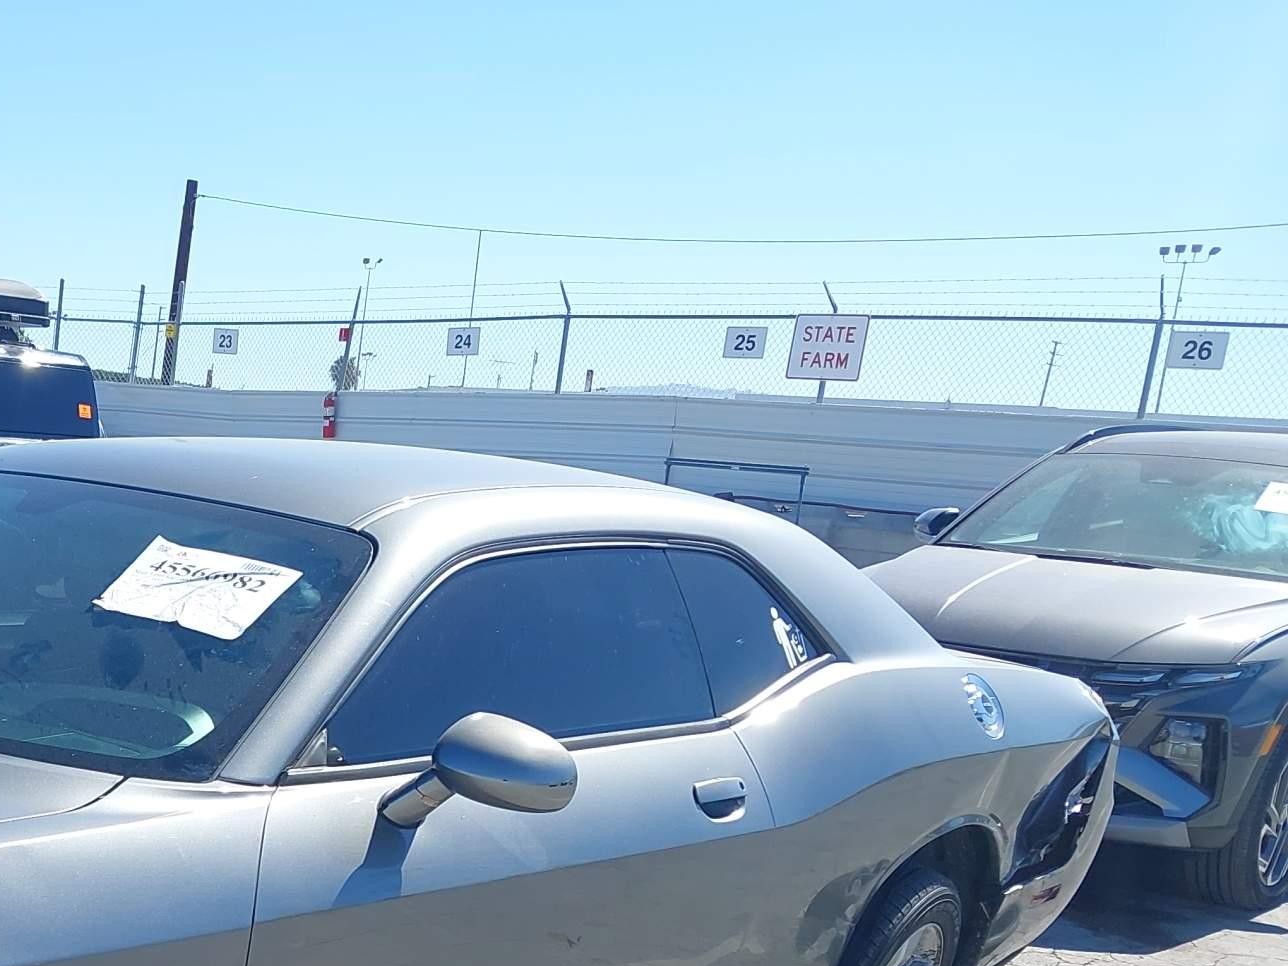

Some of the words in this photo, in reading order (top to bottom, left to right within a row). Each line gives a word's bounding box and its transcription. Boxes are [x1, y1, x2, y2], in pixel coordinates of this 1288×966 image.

[218, 335, 233, 349] 23
[454, 334, 472, 349] 24
[802, 326, 857, 343] STATE
[734, 335, 756, 351] 25
[1181, 340, 1213, 361] 26
[800, 352, 849, 369] FARM
